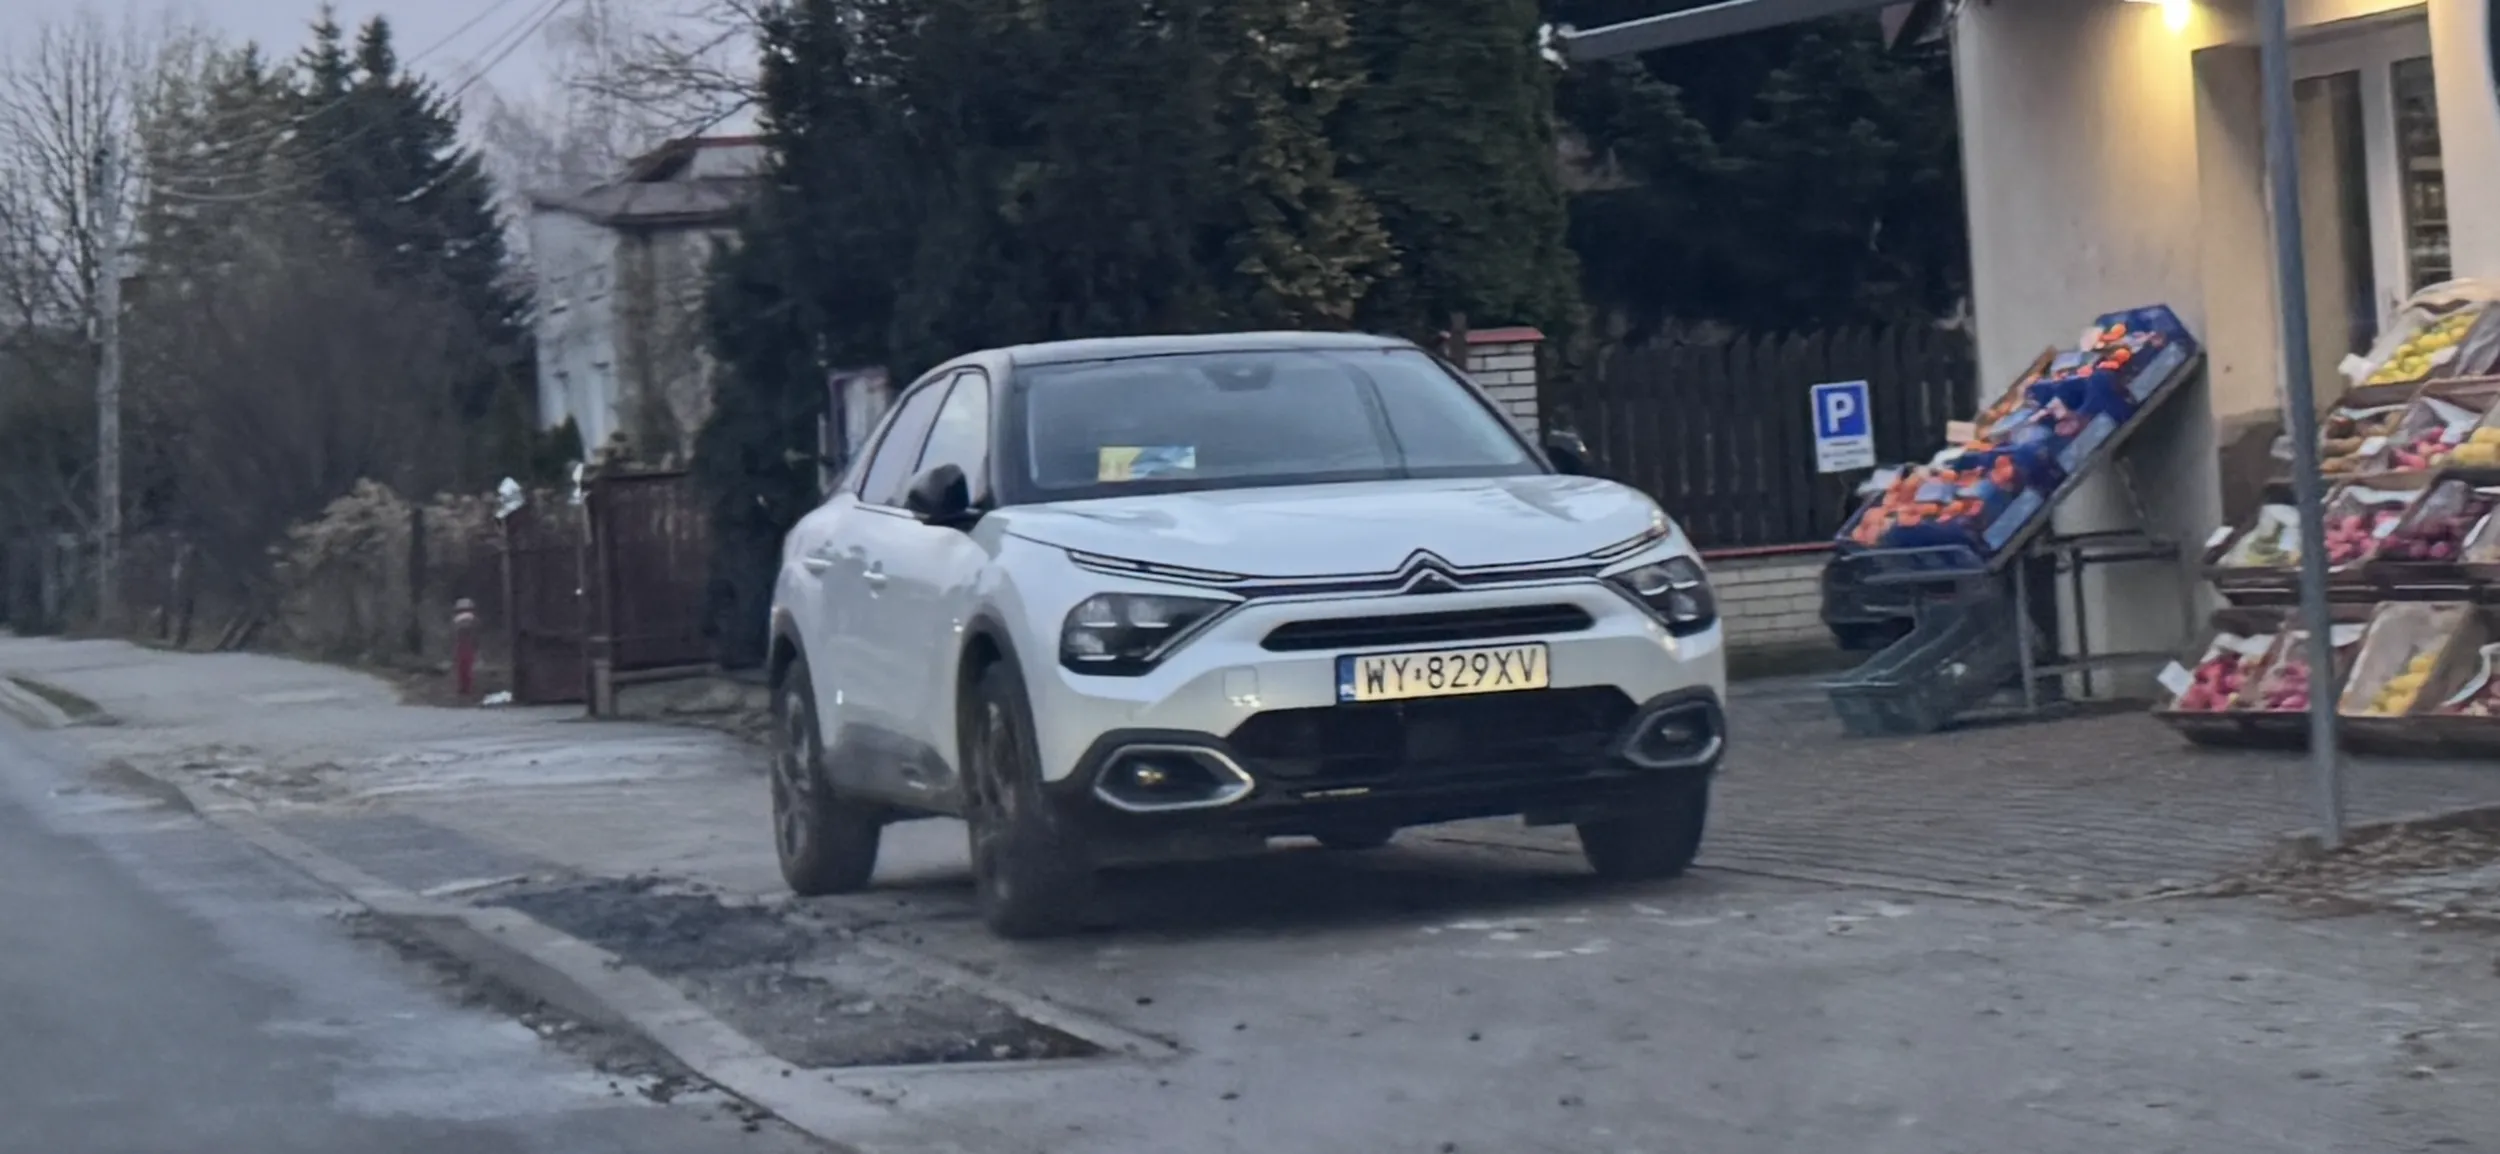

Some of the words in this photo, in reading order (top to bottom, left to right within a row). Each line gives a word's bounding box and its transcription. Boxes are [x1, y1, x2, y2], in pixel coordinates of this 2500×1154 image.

[1826, 391, 1855, 434] P
[1364, 656, 1411, 695] WY
[1427, 648, 1538, 690] 829XV
